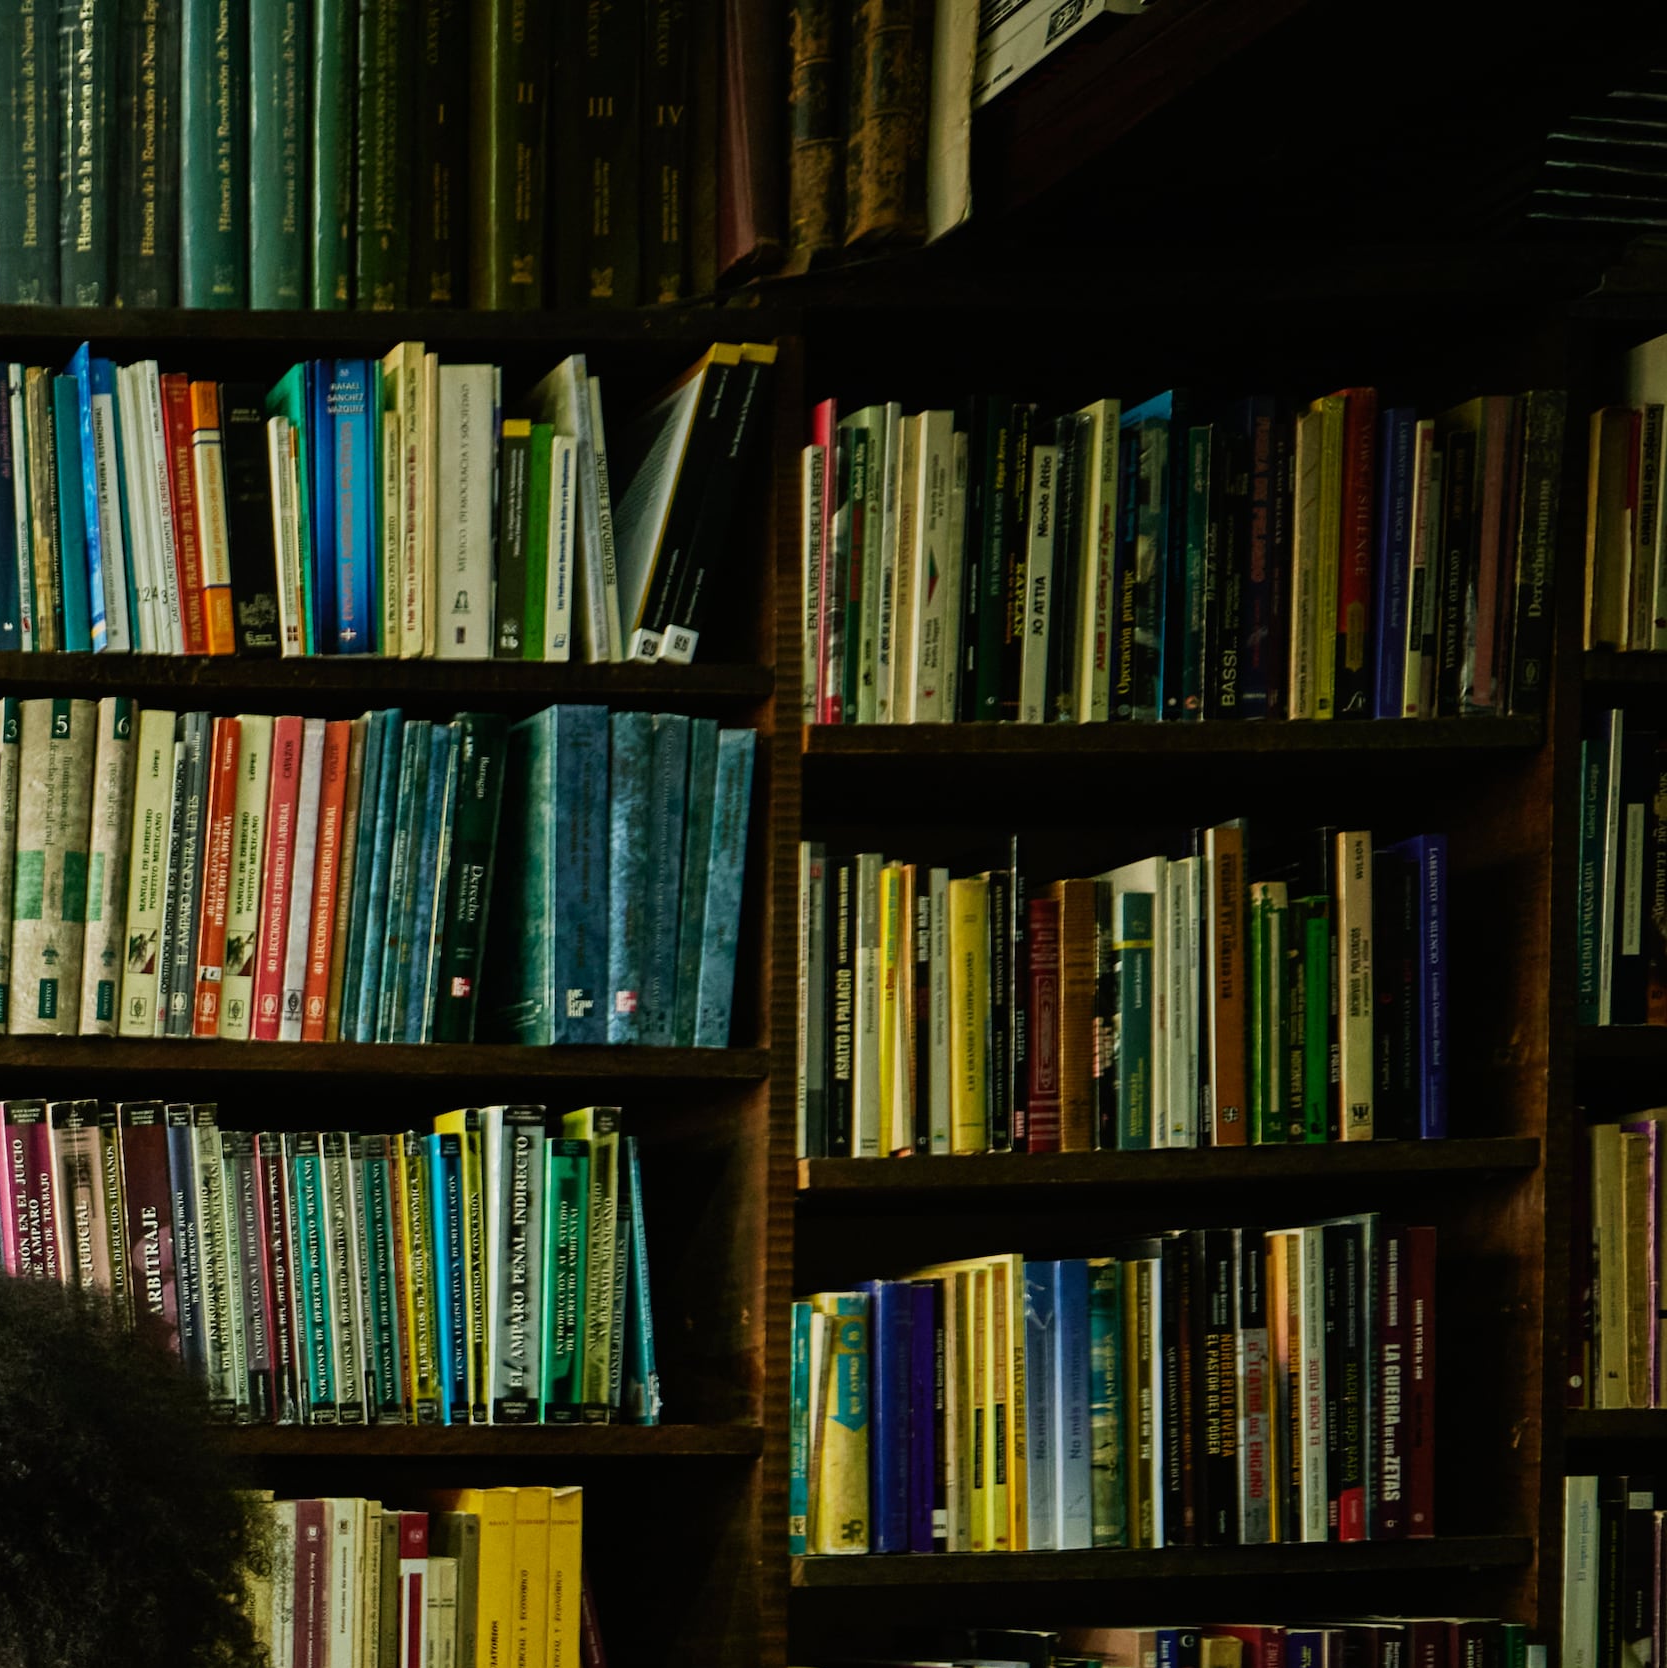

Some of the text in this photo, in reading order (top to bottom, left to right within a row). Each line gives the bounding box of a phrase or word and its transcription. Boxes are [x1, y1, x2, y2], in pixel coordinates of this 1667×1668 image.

[510, 1136, 528, 1387] EL AMPARO PENAL INDIRECTO
[1384, 1344, 1400, 1362] LA
[1384, 1366, 1400, 1426] GUERRA
[1384, 1456, 1400, 1501] ZETAS
